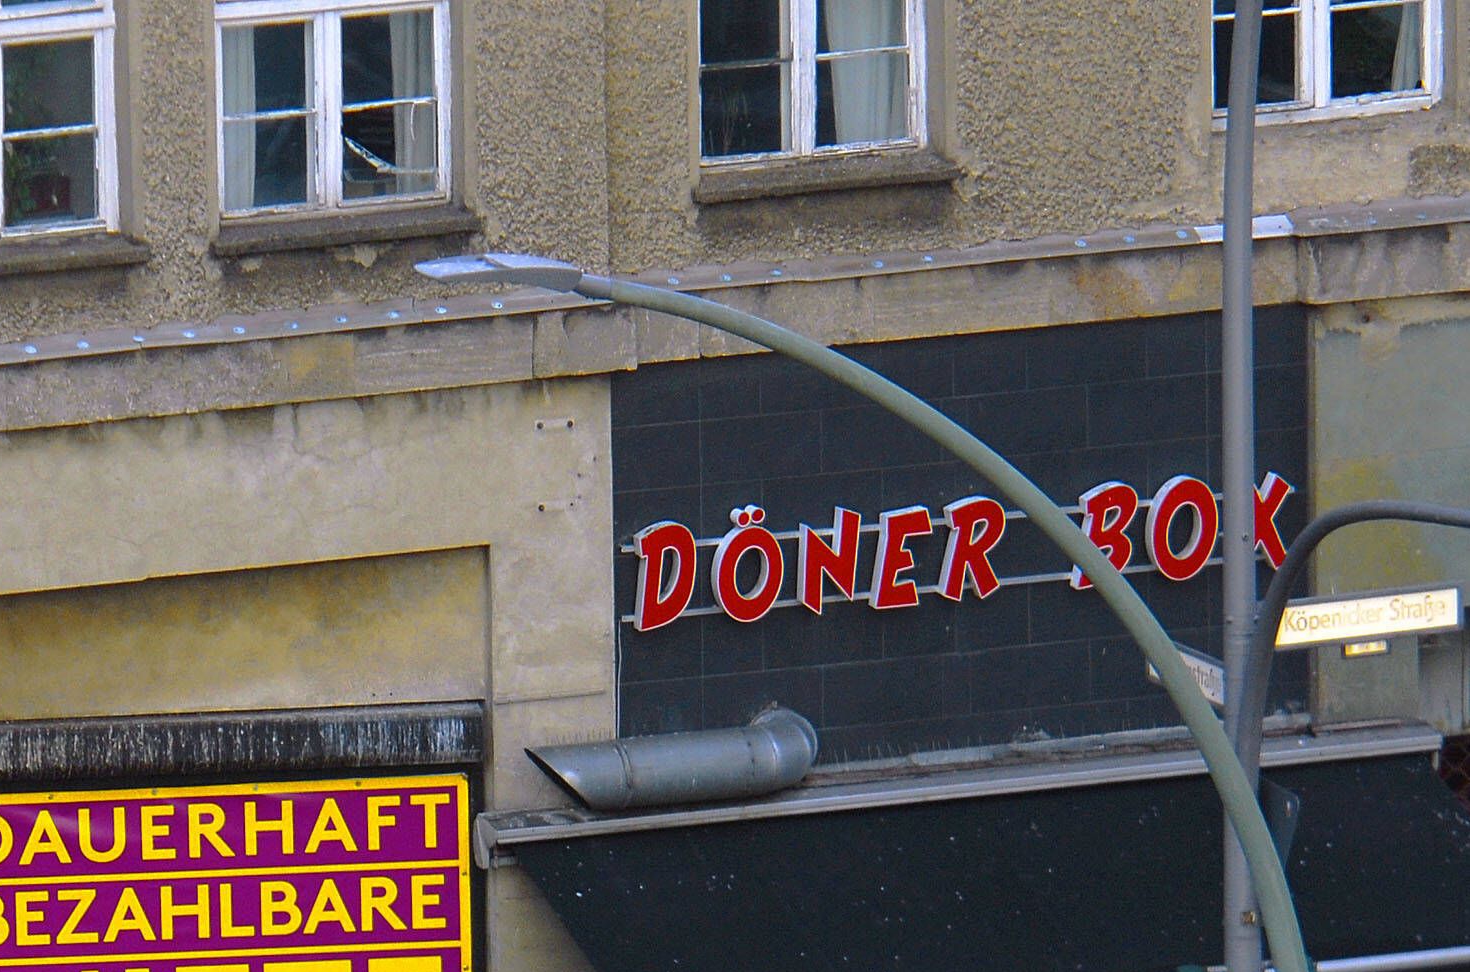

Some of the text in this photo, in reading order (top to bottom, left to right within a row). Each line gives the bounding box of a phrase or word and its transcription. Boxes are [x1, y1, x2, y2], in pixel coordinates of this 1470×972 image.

[633, 494, 1007, 632] DÖNER
[1283, 594, 1447, 632] Köpenicker Straße
